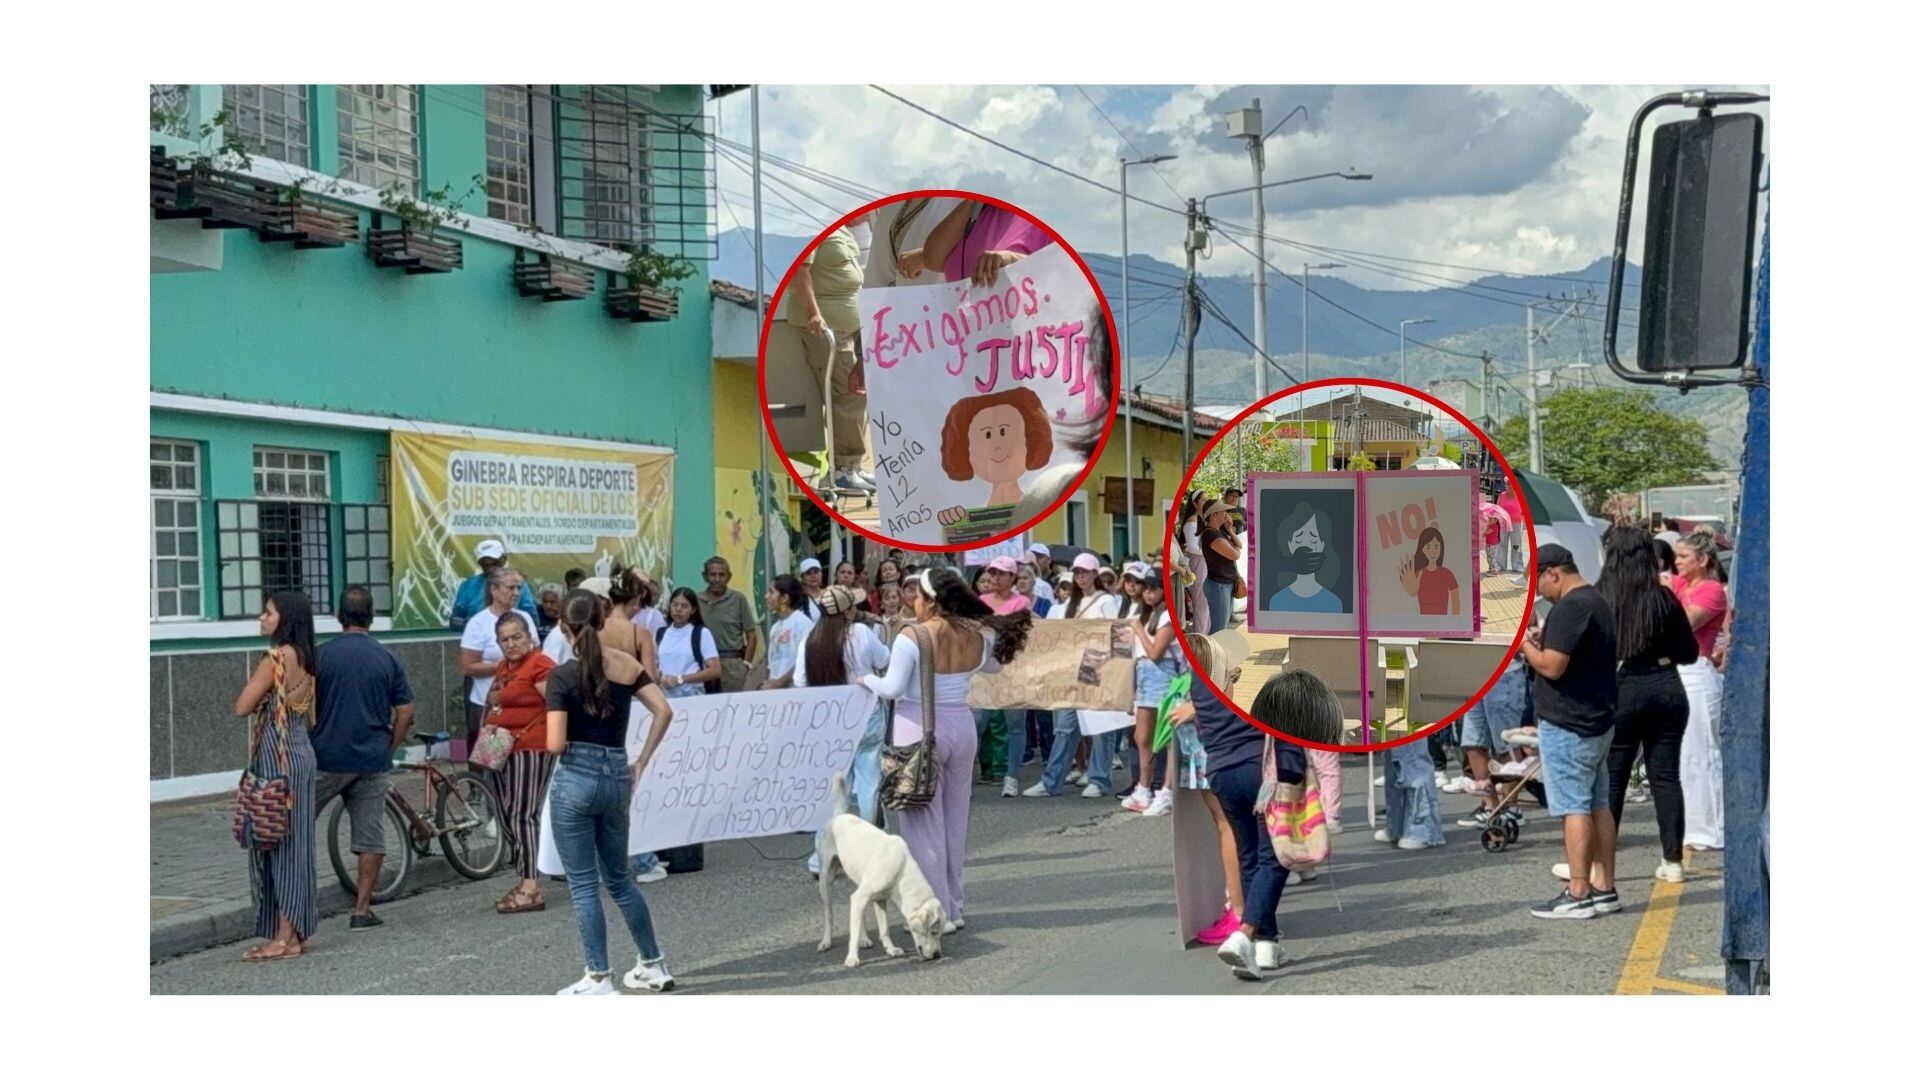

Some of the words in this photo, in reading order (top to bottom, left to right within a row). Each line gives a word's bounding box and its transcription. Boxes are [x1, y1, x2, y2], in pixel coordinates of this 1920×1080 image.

[872, 410, 902, 446] Yo
[451, 458, 518, 485] GINEBRA
[521, 463, 577, 489] RESPIRA
[579, 467, 635, 491] DEPORTE
[875, 439, 926, 478] tenía
[451, 484, 485, 511] SUB
[489, 486, 527, 512] SEDE
[530, 489, 588, 514] OFICIAL
[591, 491, 608, 515] DE
[610, 493, 635, 516] LOS
[452, 514, 483, 527] JUEGOS
[553, 517, 577, 529] SORDO
[578, 518, 636, 530] DEPARTAMENTALES
[1375, 497, 1440, 550] NO!
[506, 534, 511, 545] Y
[512, 534, 594, 546] PARADEPARTAMENTALES
